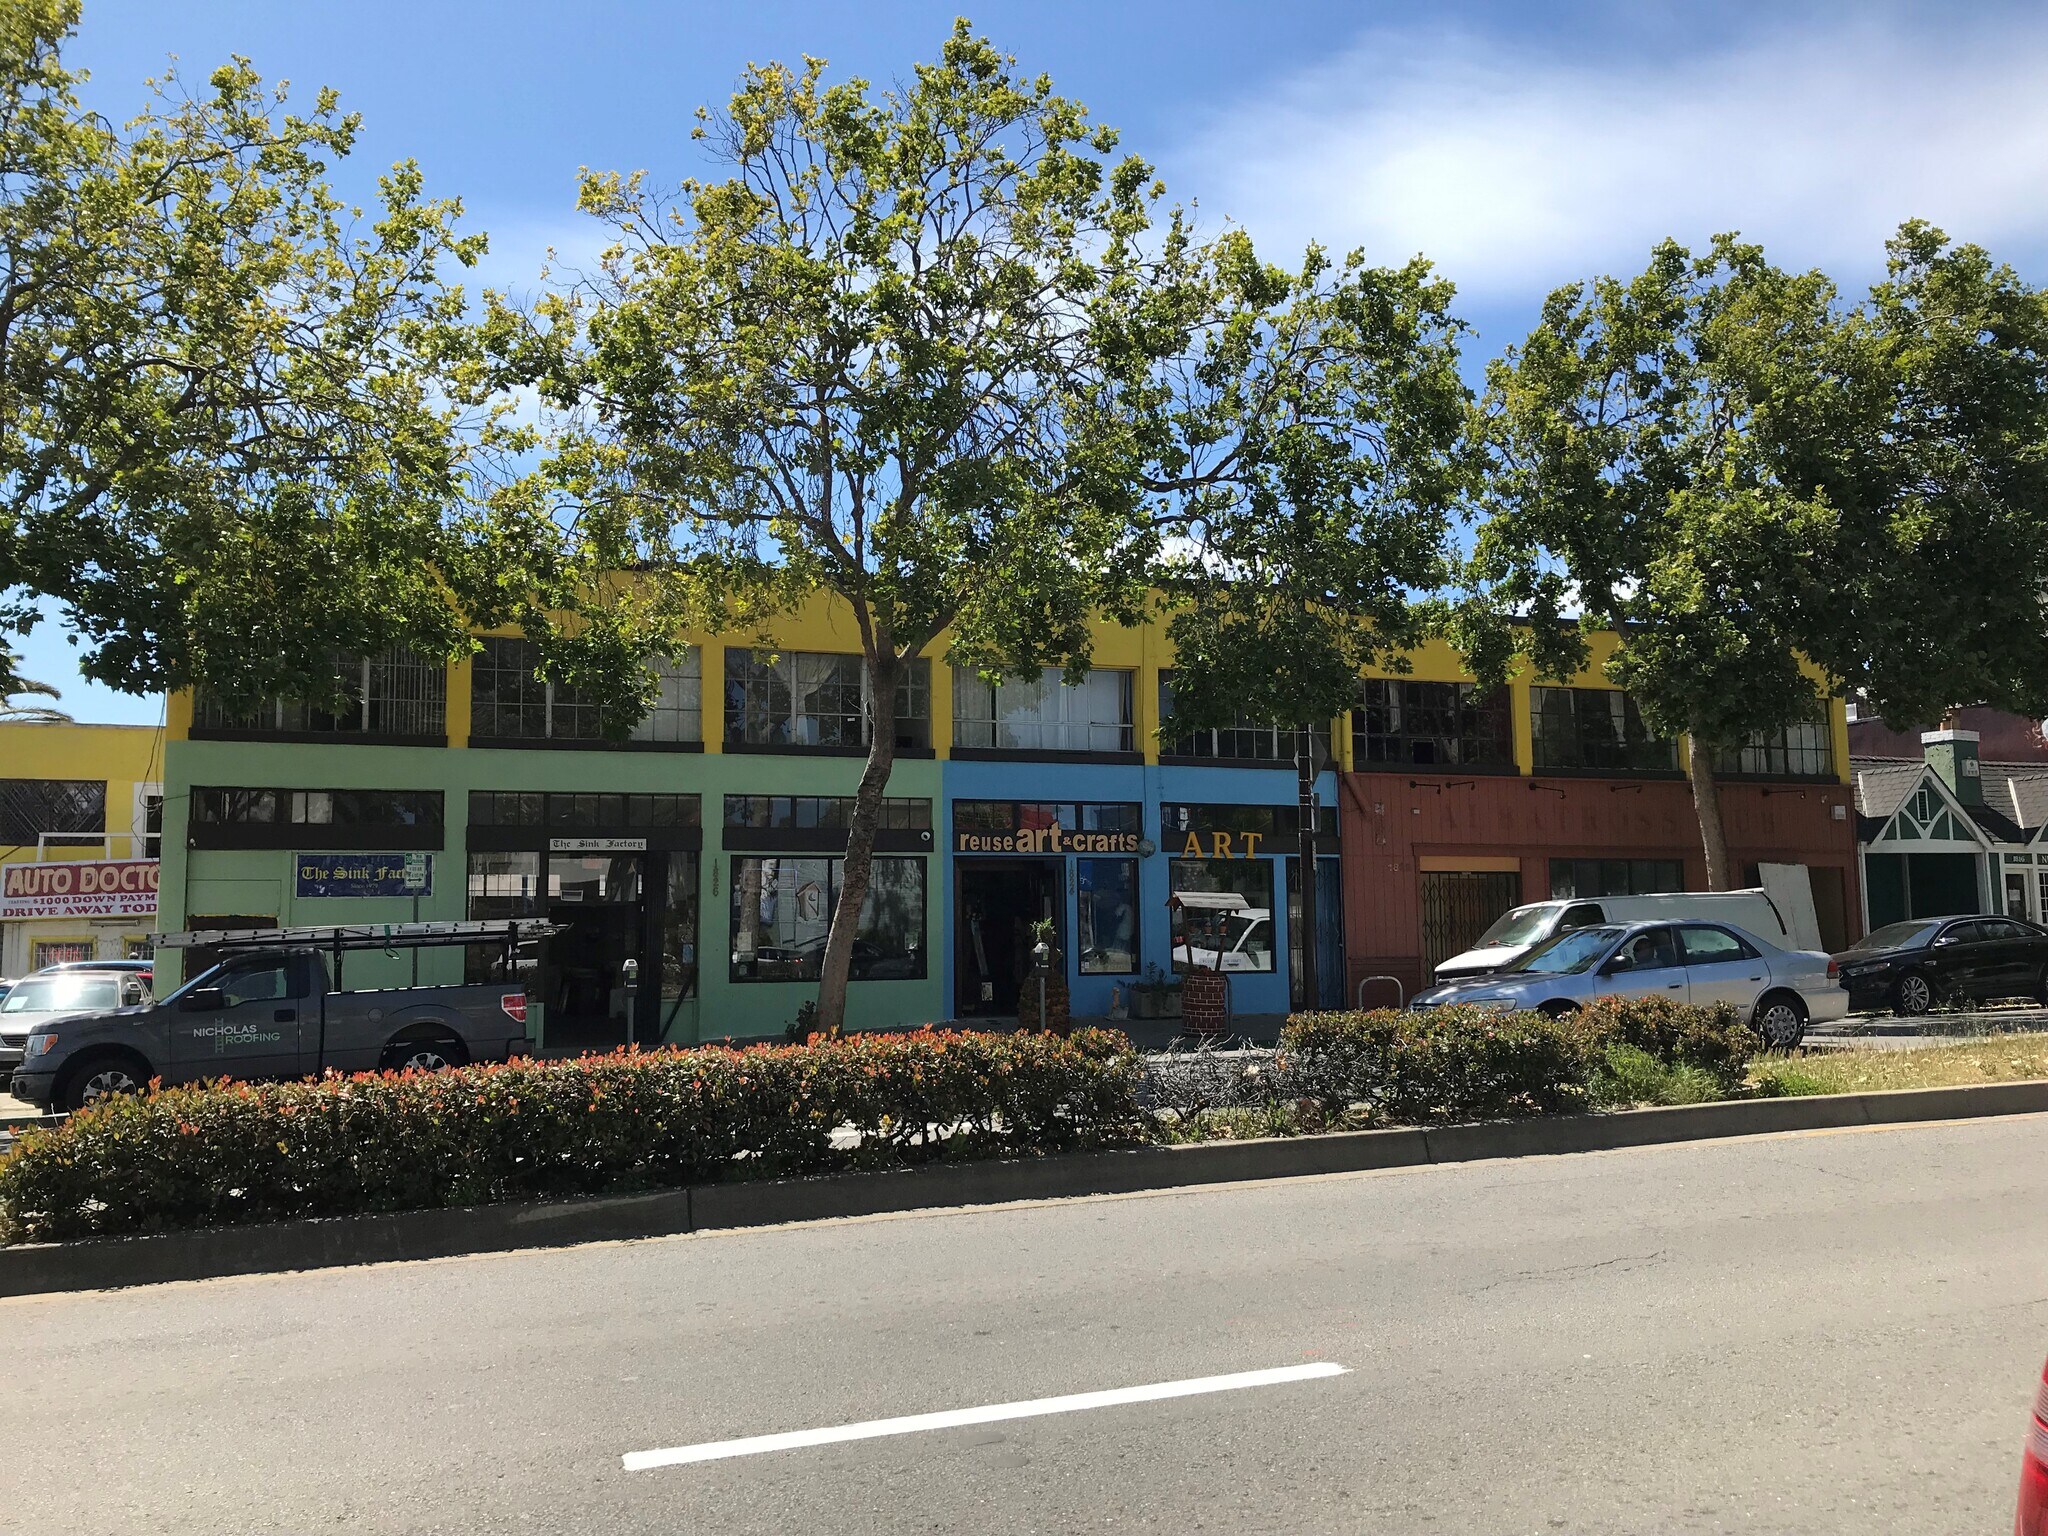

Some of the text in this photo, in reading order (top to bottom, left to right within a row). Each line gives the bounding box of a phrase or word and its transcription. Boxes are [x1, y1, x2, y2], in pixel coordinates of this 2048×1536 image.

[959, 821, 1138, 853] reuse art & crafts
[552, 839, 644, 850] The Sink Factory
[1180, 831, 1263, 859] ART
[300, 866, 330, 882] The
[332, 866, 371, 880] Sink
[6, 867, 73, 896] AUTO
[33, 897, 70, 905] $1000
[72, 895, 116, 904] DOWN
[119, 893, 156, 902] PAYM
[2, 907, 59, 917] DRIVE
[63, 904, 115, 915] AWAY
[193, 1024, 258, 1038] NICHOLAS
[225, 1032, 281, 1045] ROOFING
